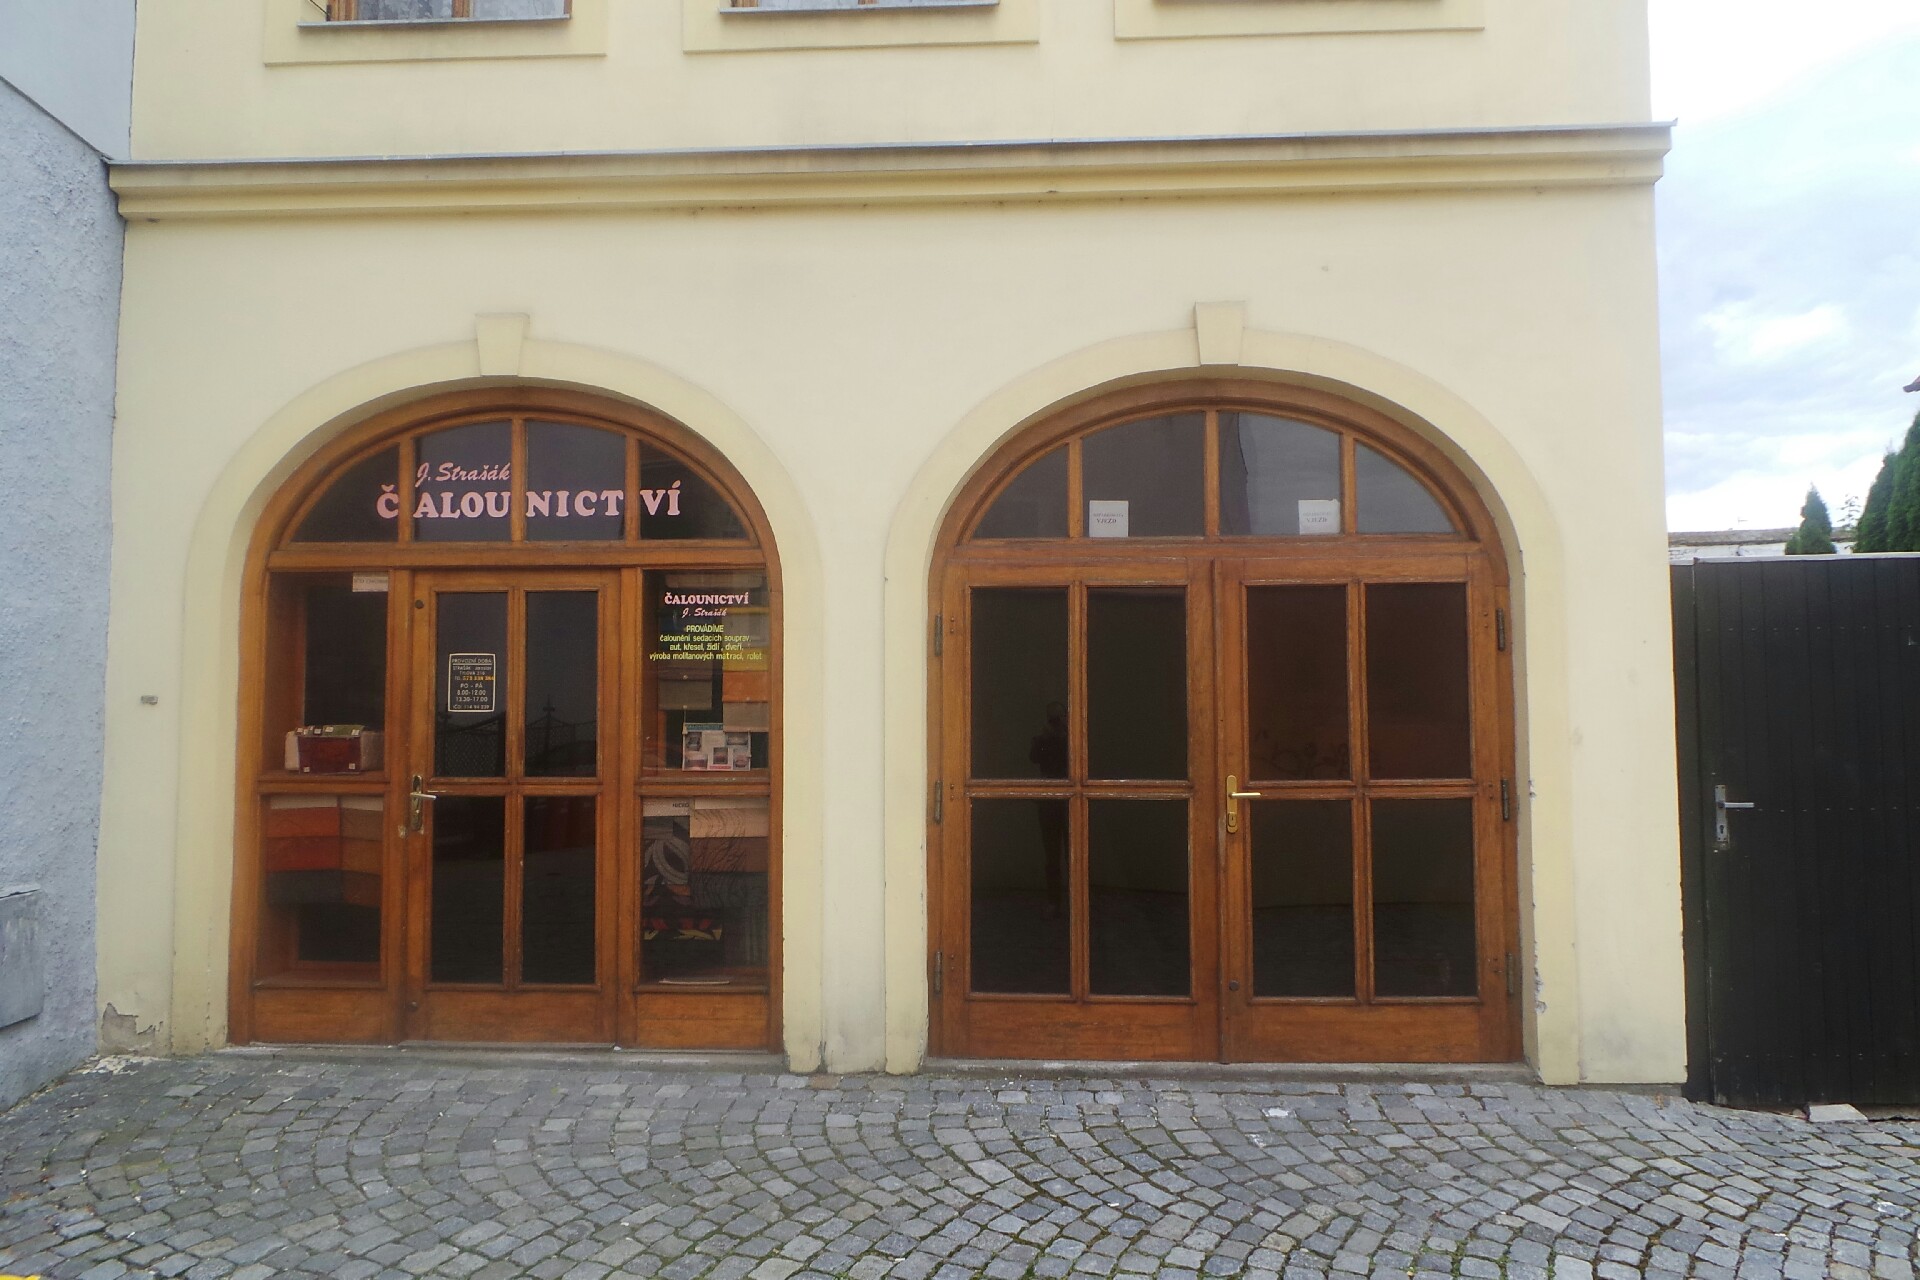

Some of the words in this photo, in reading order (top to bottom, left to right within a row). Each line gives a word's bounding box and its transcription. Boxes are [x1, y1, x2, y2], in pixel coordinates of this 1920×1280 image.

[415, 462, 431, 488] J.
[436, 462, 511, 482] Strašák
[664, 592, 749, 604] ČALOUNICTVÍ
[694, 607, 727, 617] Strašák
[659, 634, 691, 642] čalounění
[692, 633, 722, 642] sedacích
[649, 652, 671, 661] výroba
[672, 651, 714, 662] molitanových
